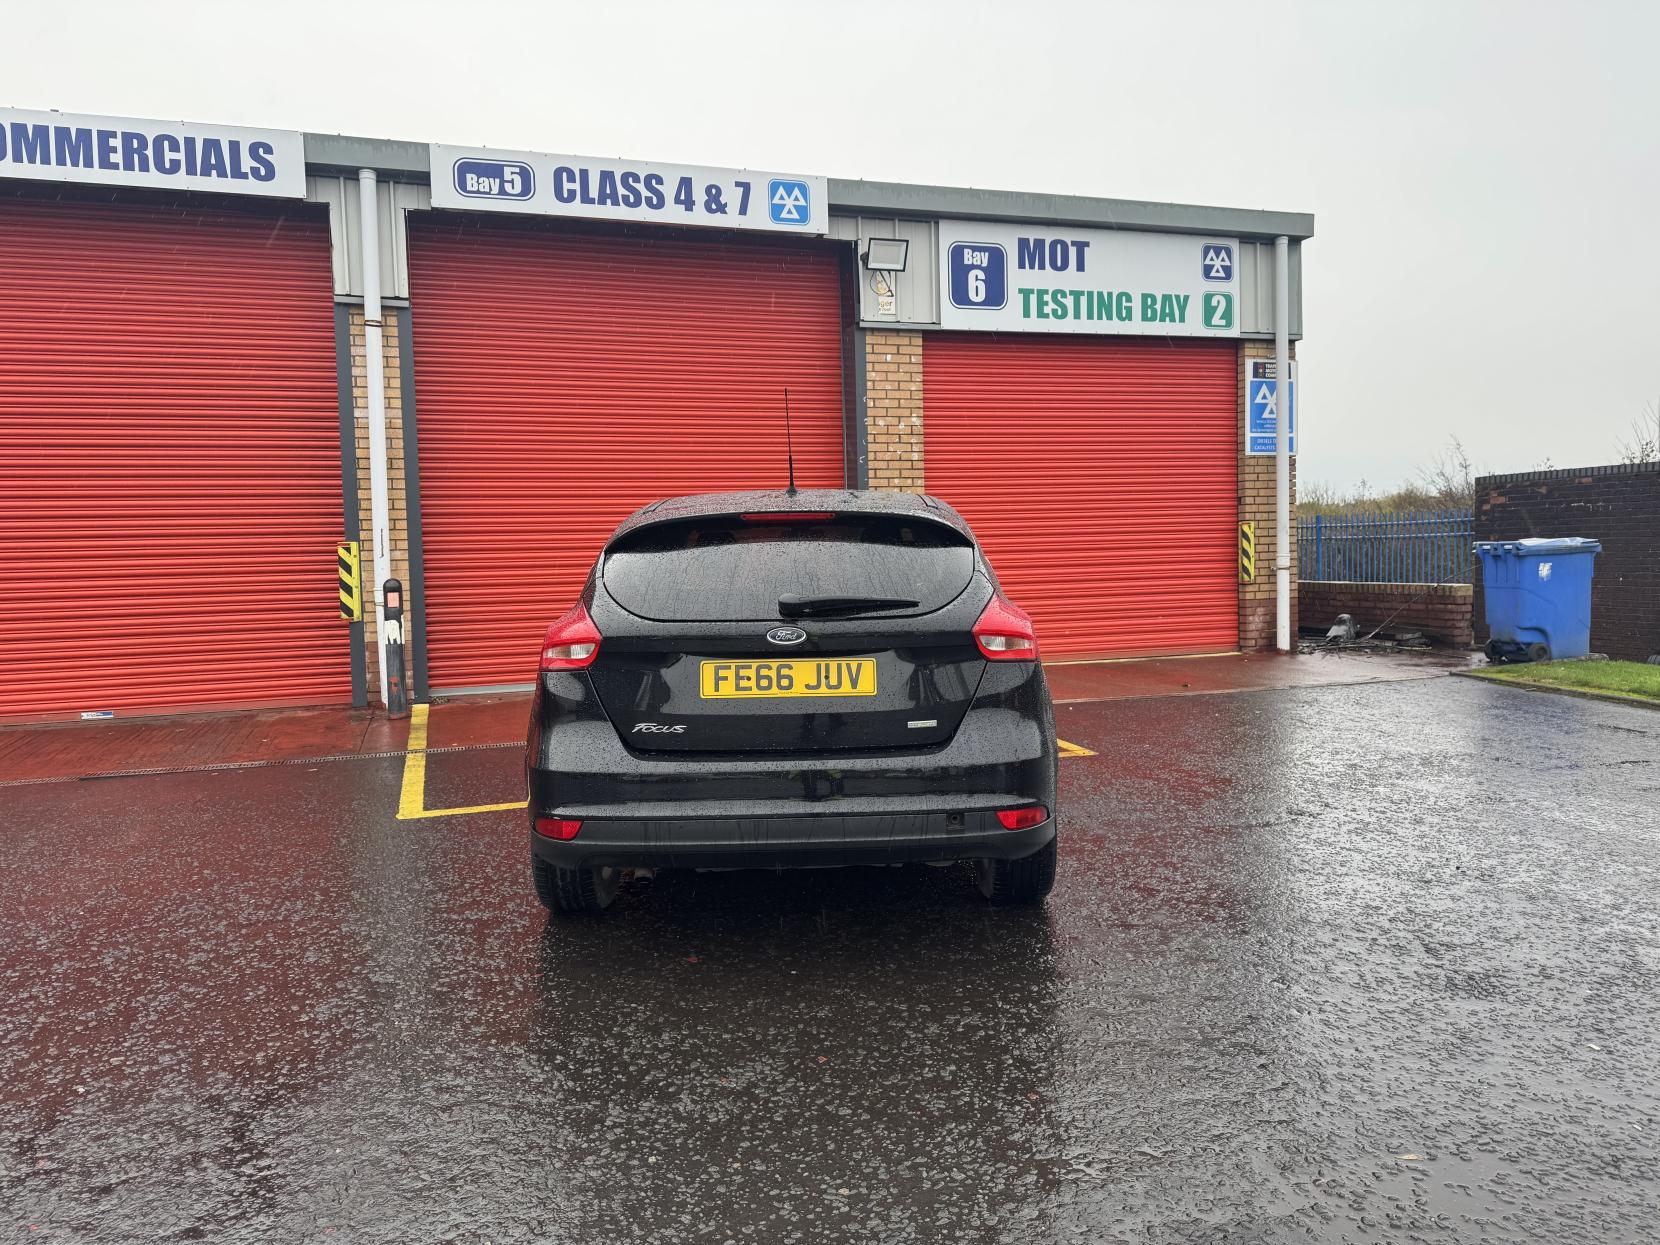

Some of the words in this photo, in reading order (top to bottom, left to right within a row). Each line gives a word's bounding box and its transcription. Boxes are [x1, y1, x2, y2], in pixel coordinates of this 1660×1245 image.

[0, 121, 276, 182] MMERCIALS
[466, 173, 499, 195] Bay
[503, 166, 522, 195] 5
[553, 166, 666, 211] CLASS
[674, 176, 695, 212] 4
[704, 184, 728, 215] &
[734, 181, 751, 216] 7
[963, 249, 989, 266] Bay
[1017, 237, 1090, 272] MOT
[967, 269, 986, 303] 6
[1018, 288, 1133, 322] TESTING
[1140, 292, 1191, 323] BAY
[1211, 294, 1227, 326] 2
[714, 663, 794, 692] FE66
[804, 663, 862, 690] JUV
